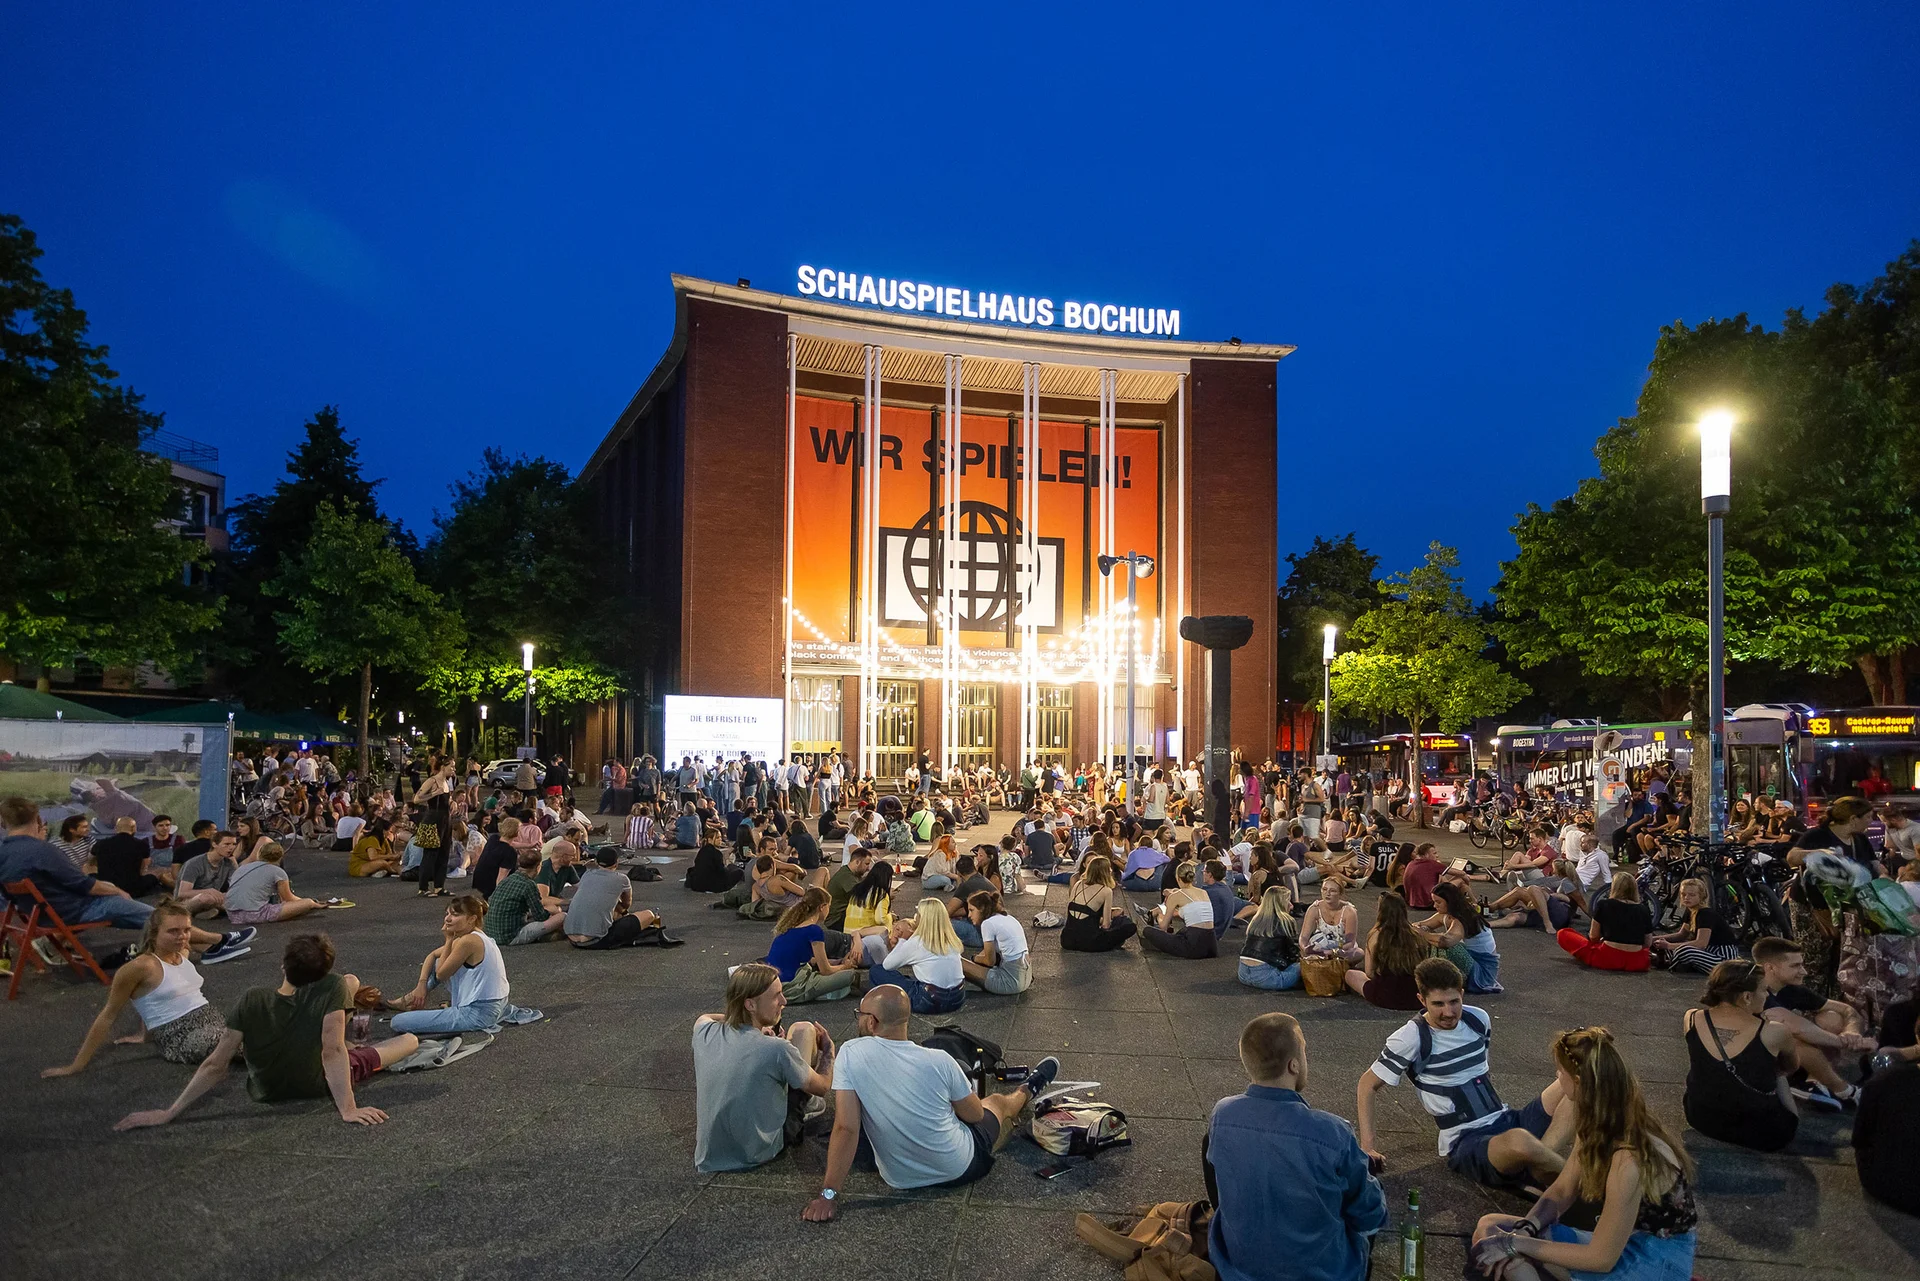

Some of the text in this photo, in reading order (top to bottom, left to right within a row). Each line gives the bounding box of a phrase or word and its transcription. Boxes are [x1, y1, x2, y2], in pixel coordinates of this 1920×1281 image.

[797, 264, 1180, 336] SCHAUSPIELHAUS BOCHUM
[922, 439, 1131, 488] SPIELEN!
[880, 654, 900, 662] and
[973, 649, 1015, 658] violence
[690, 714, 757, 724] DIE BEFRISTETEN
[1807, 716, 1915, 735] 353 Castrop-Rauxel
[1512, 738, 1535, 748] BOGESTRA
[680, 749, 694, 757] ICH
[696, 749, 708, 757] IST
[711, 750, 724, 758] EIN
[1527, 740, 1666, 789] IMMER GUT VUNDEN!
